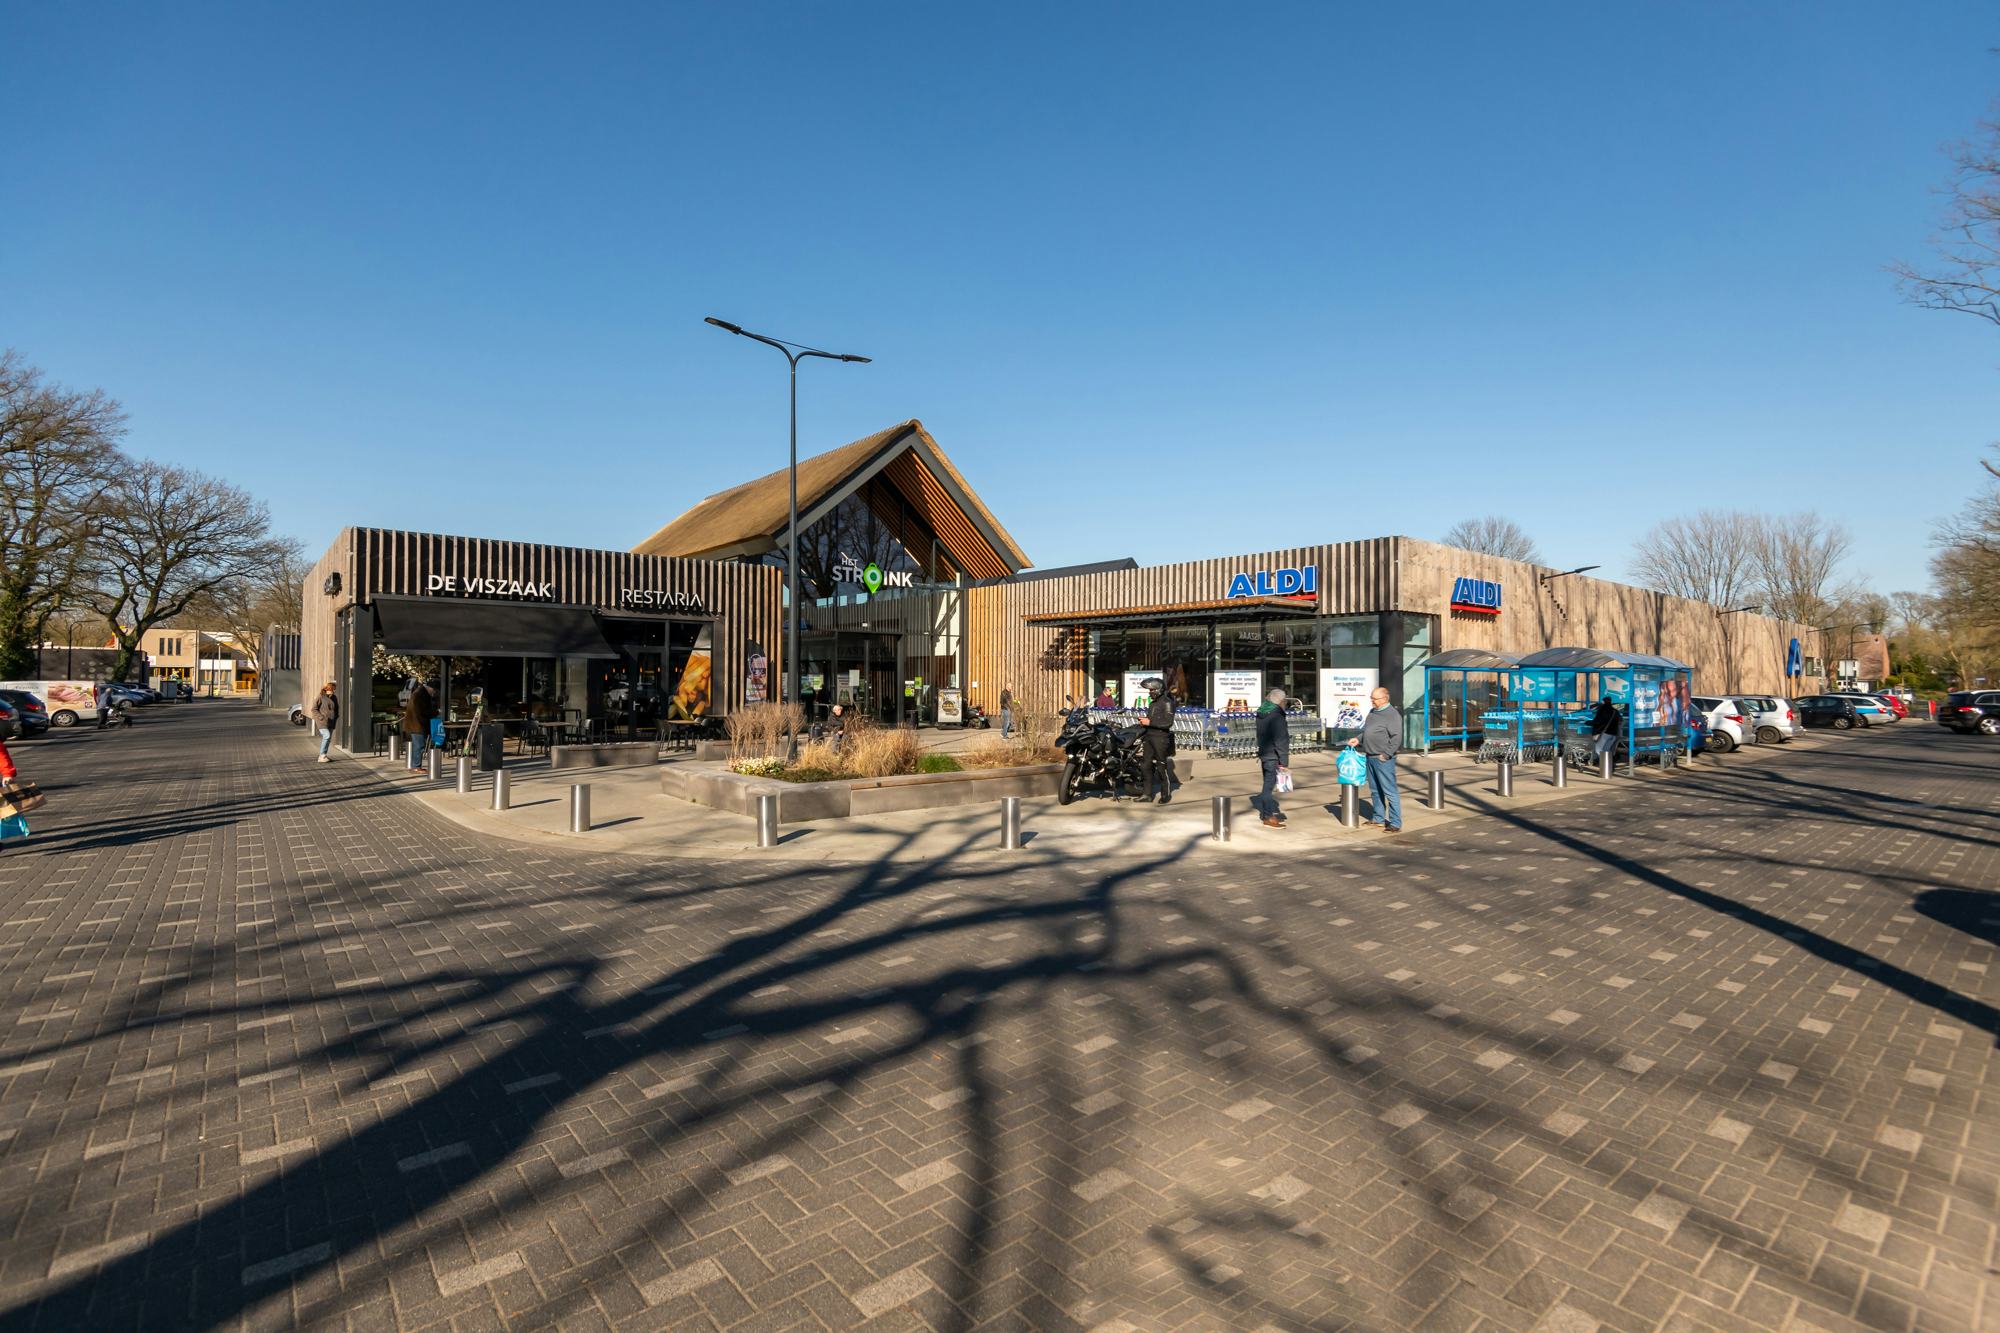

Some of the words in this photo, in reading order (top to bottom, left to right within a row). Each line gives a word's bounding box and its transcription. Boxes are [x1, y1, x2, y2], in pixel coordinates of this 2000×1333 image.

[841, 558, 858, 566] HET
[428, 574, 456, 591] DE
[463, 577, 552, 597] VISZAAK
[831, 565, 913, 589] STROINK
[1225, 565, 1317, 599] ALDI
[621, 588, 702, 607] RESTARIA
[1451, 576, 1502, 608] ALDI
